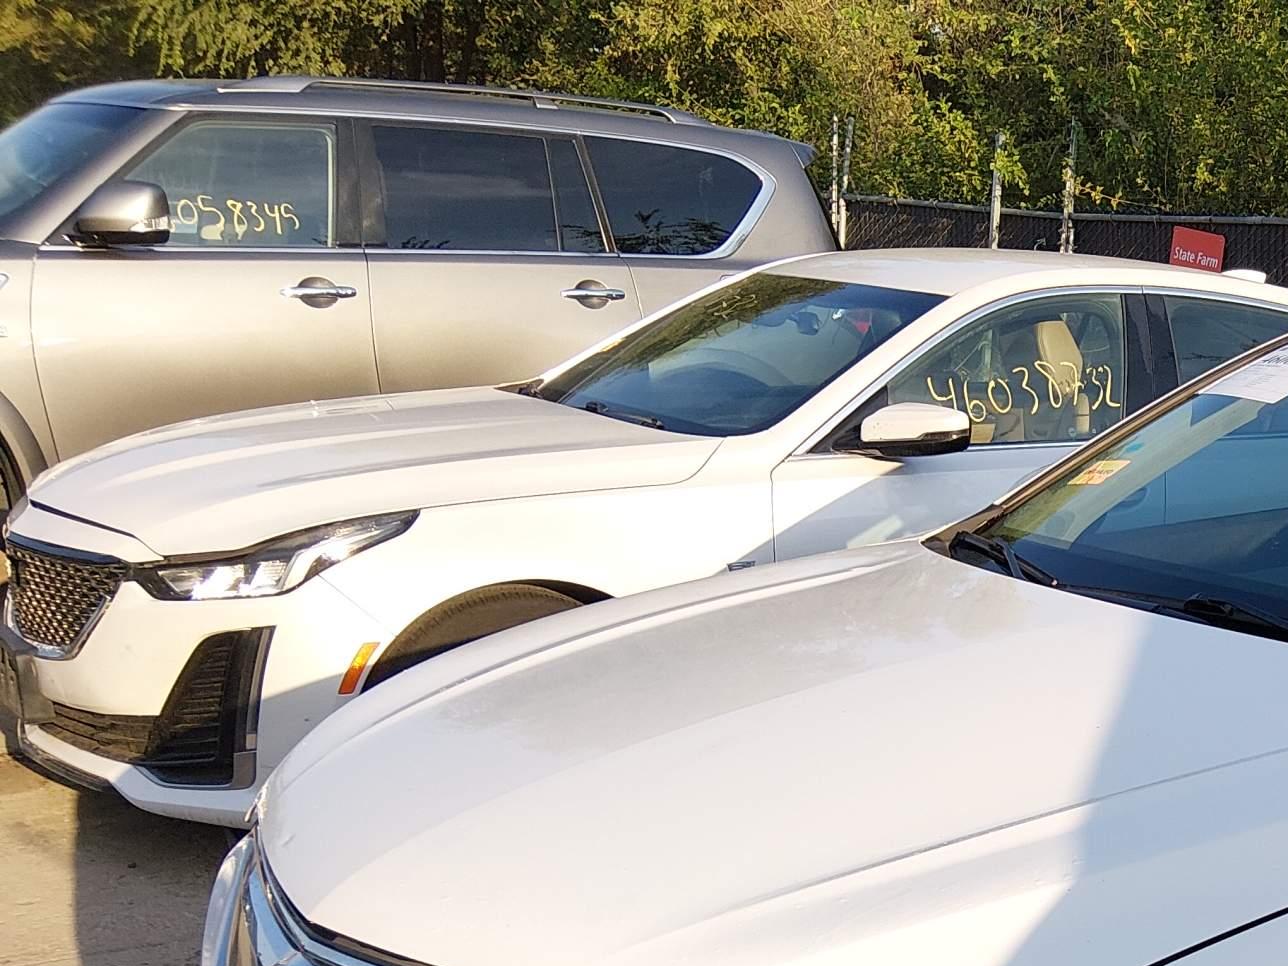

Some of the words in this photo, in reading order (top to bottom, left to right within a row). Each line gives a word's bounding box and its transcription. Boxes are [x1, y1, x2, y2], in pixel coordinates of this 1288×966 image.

[170, 195, 300, 240] 058345
[1173, 246, 1196, 263] State
[1196, 252, 1219, 269] Farm
